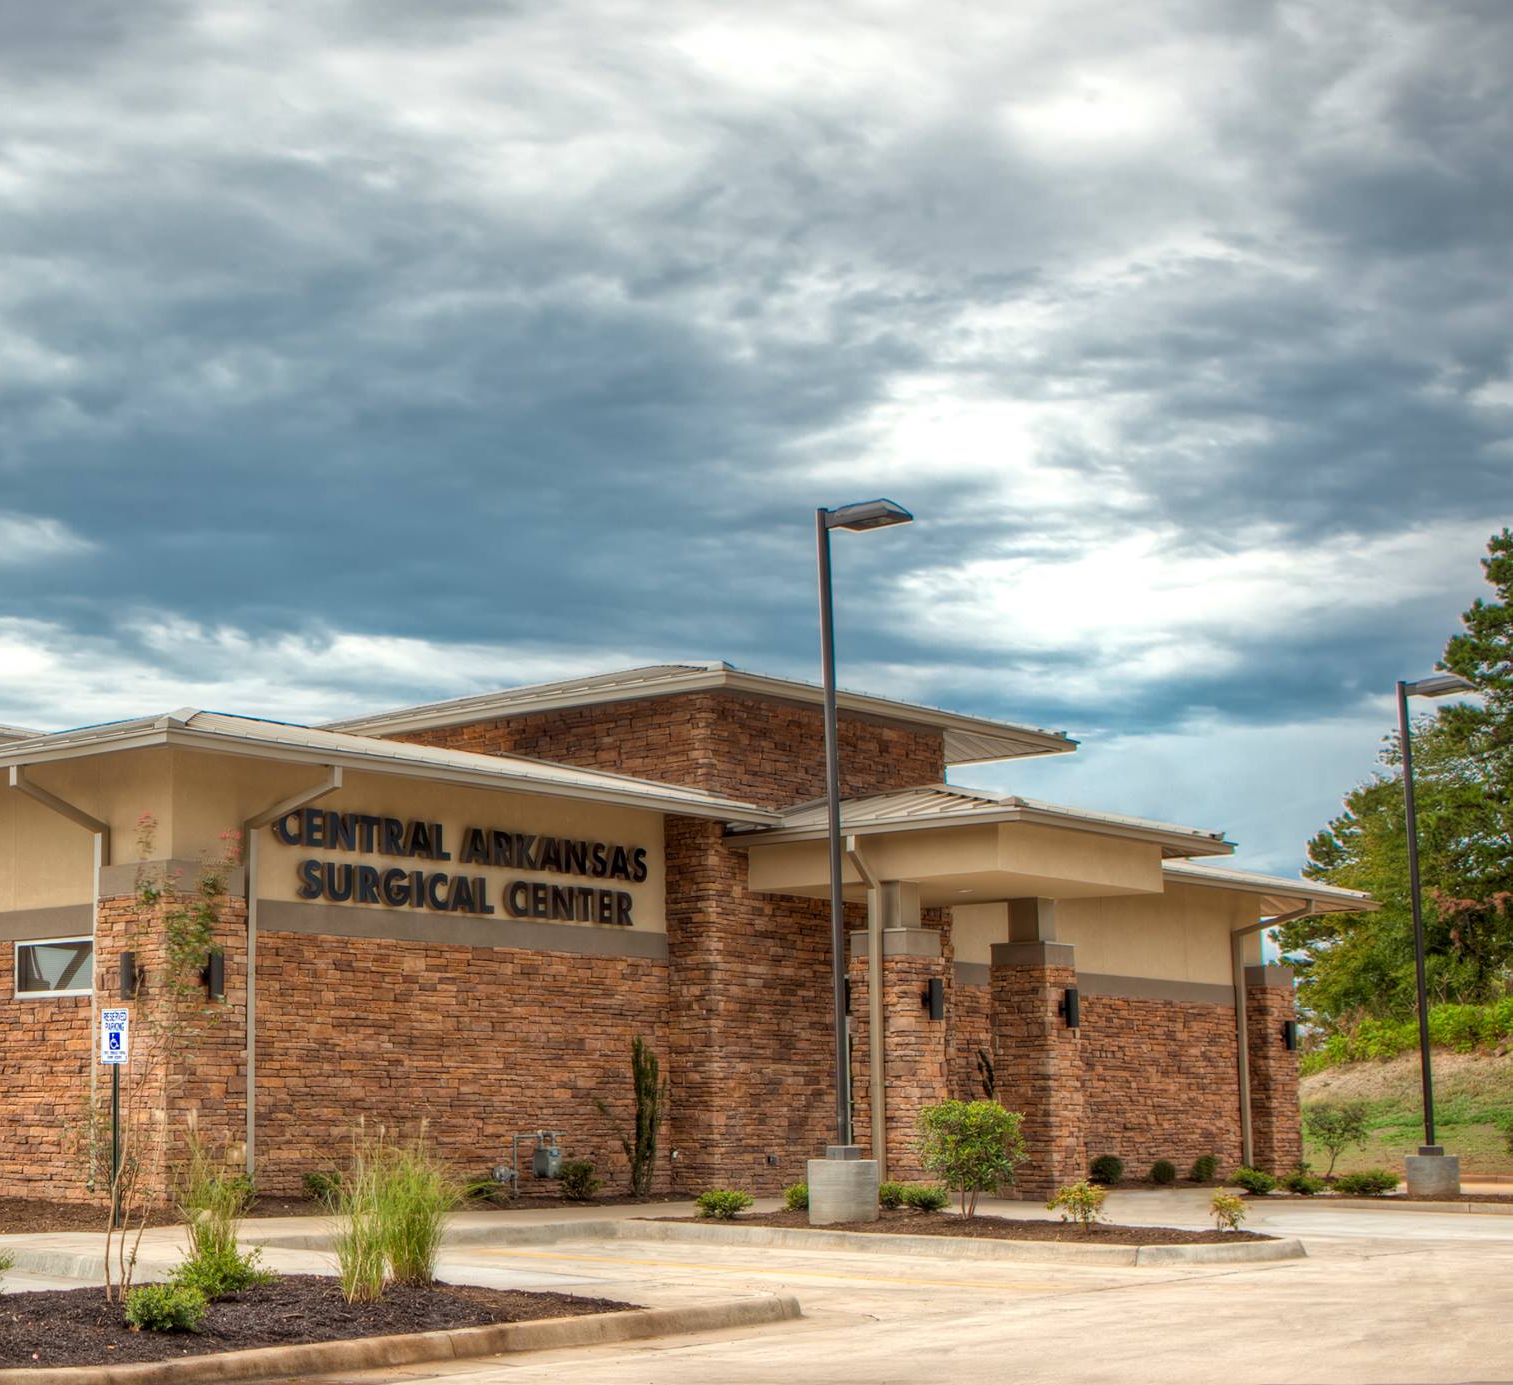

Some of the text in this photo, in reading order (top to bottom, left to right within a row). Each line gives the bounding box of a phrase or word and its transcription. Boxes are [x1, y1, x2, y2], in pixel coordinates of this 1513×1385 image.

[274, 807, 647, 883] CENTRAL ARKANSAS
[298, 859, 633, 926] SURGICAL CENTER
